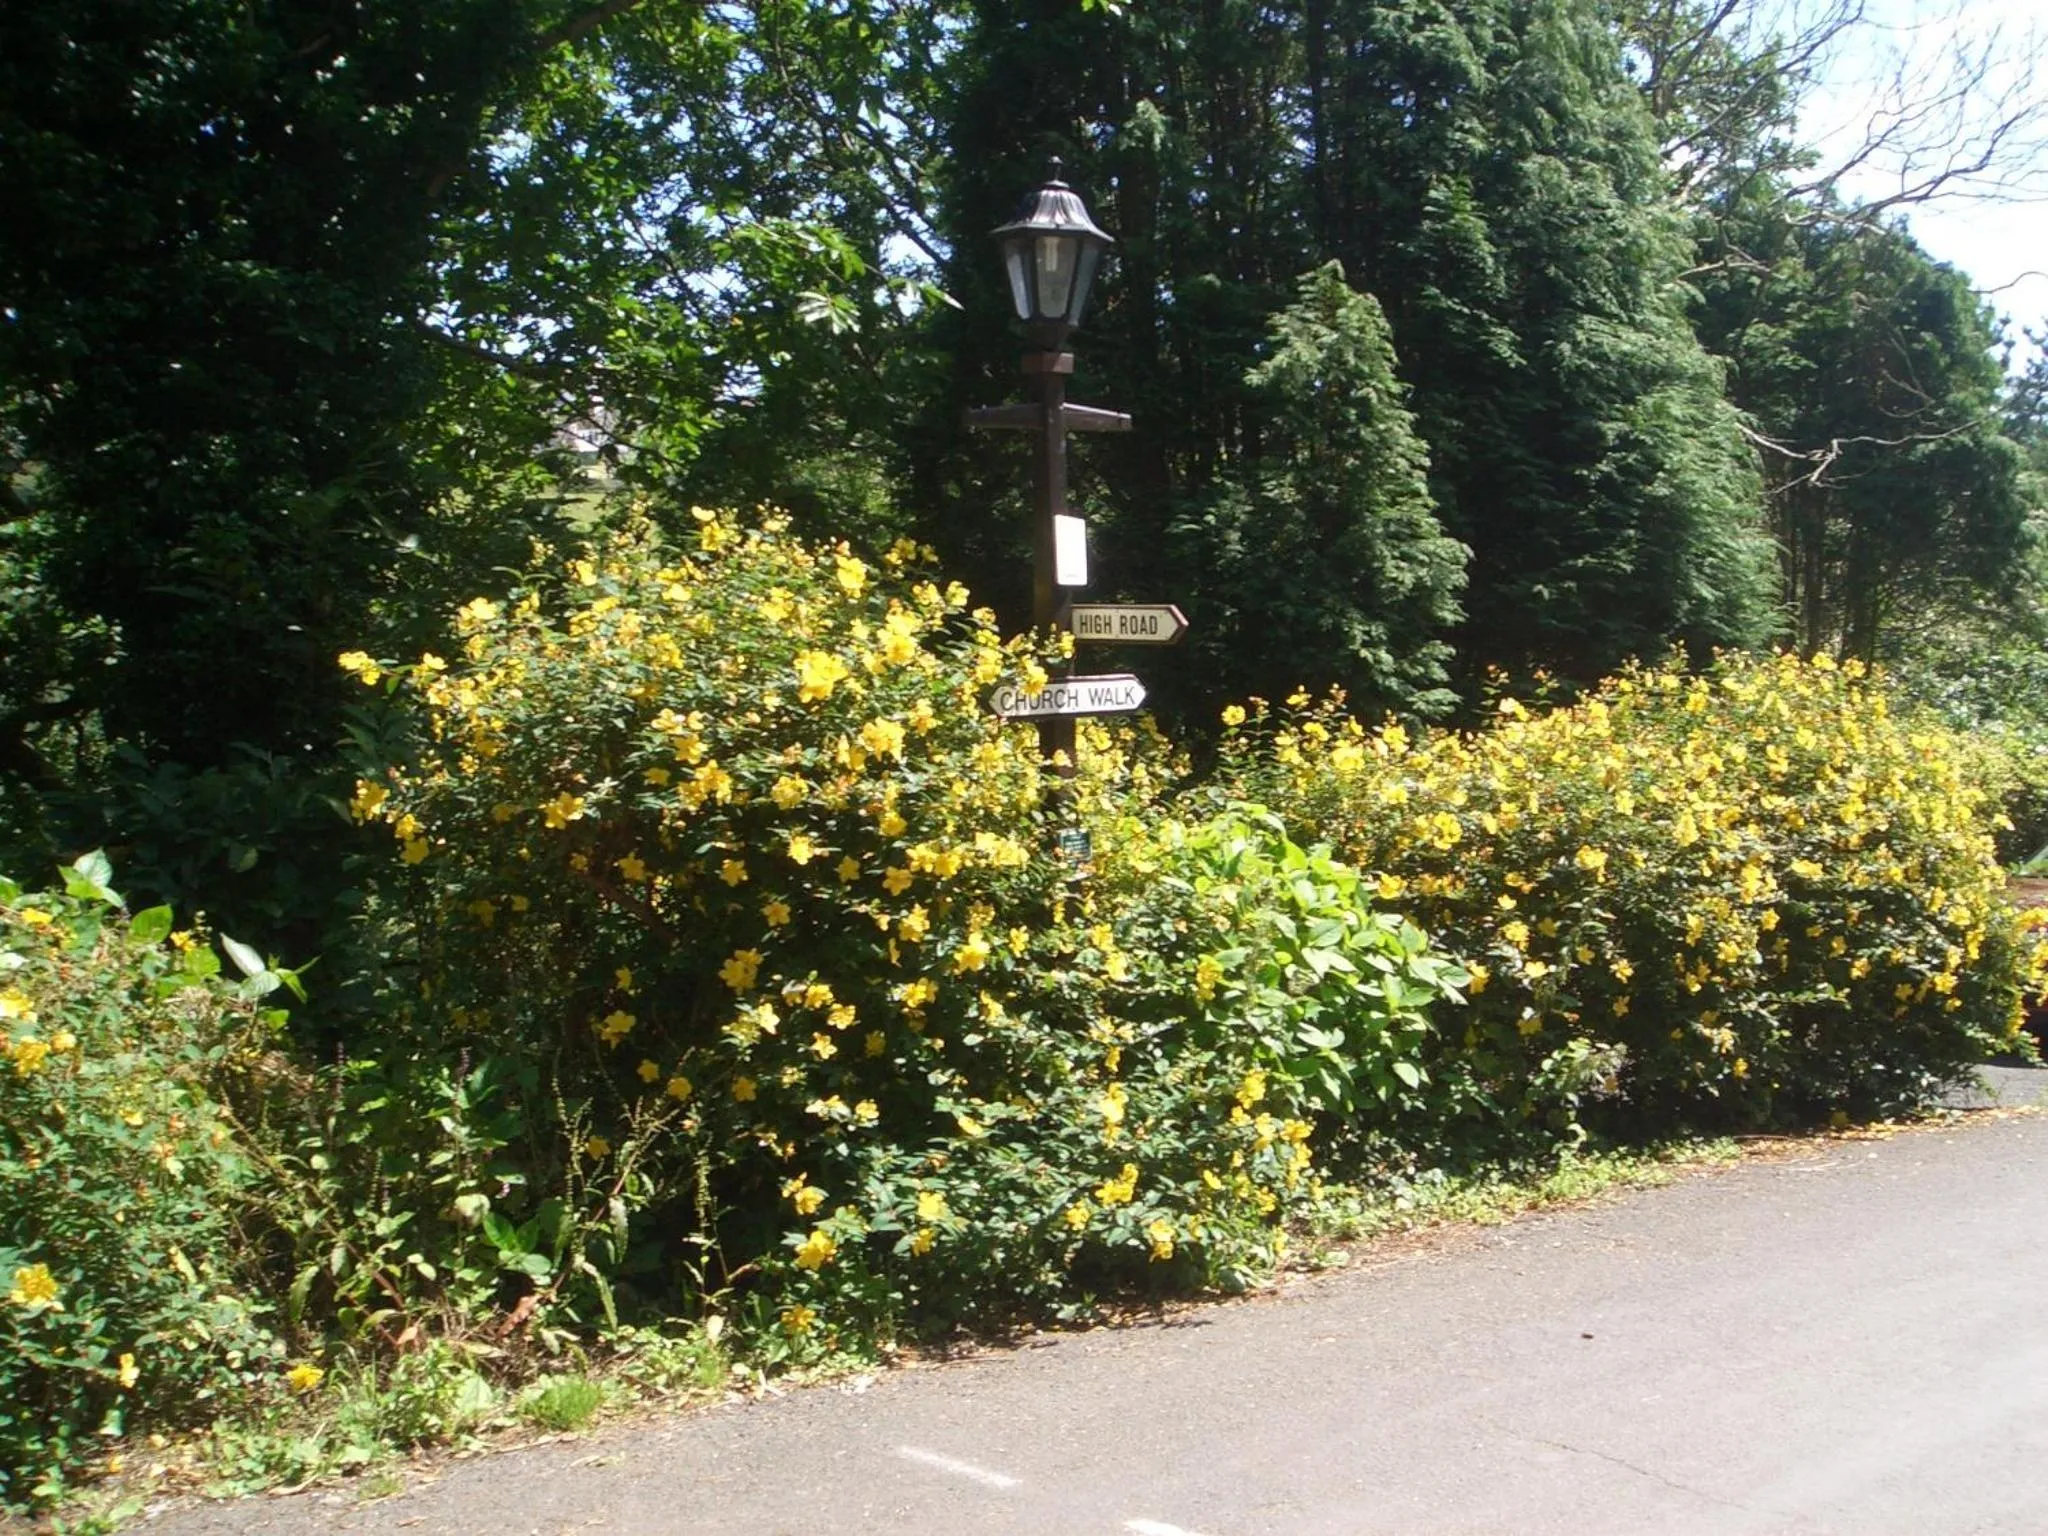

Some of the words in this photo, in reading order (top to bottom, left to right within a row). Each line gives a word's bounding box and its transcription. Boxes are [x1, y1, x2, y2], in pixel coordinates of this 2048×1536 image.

[1079, 614, 1113, 635] HIGH
[1119, 615, 1159, 635] ROAD
[1000, 689, 1079, 712] CHURCH
[1088, 686, 1136, 706] WALK
